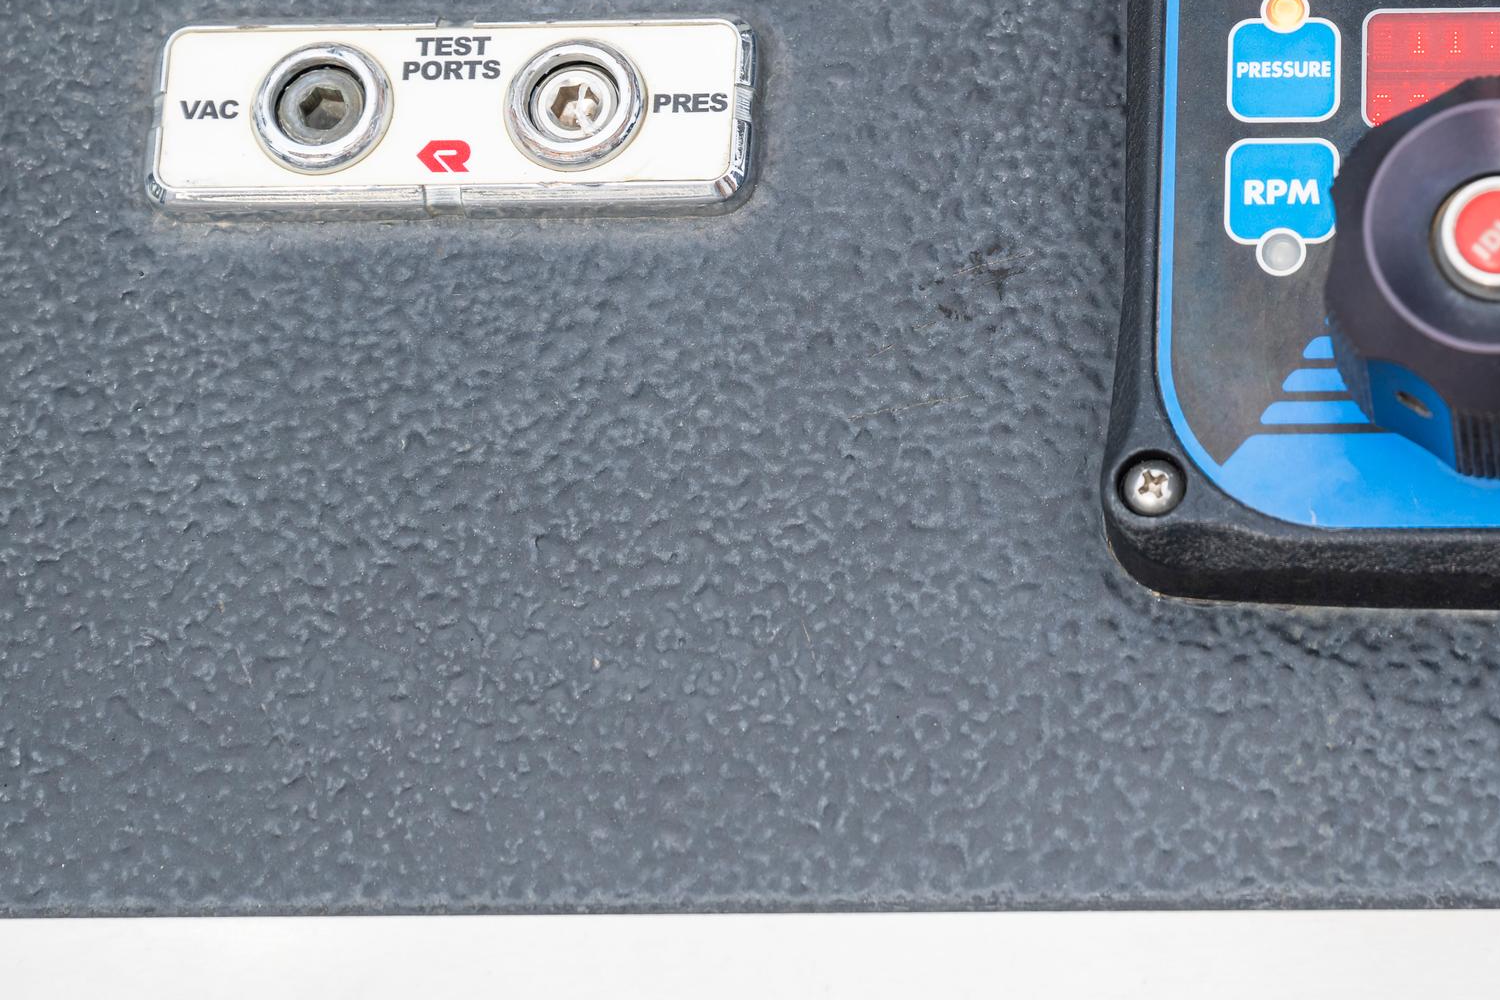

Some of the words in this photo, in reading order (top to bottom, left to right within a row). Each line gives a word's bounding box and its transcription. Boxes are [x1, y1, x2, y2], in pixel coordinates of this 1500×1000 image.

[415, 37, 491, 57] TEST
[402, 60, 501, 82] PORTS
[1236, 60, 1331, 79] PRESSURE
[180, 100, 240, 120] VAC
[653, 93, 729, 114] PRES
[1243, 180, 1320, 205] RPM
